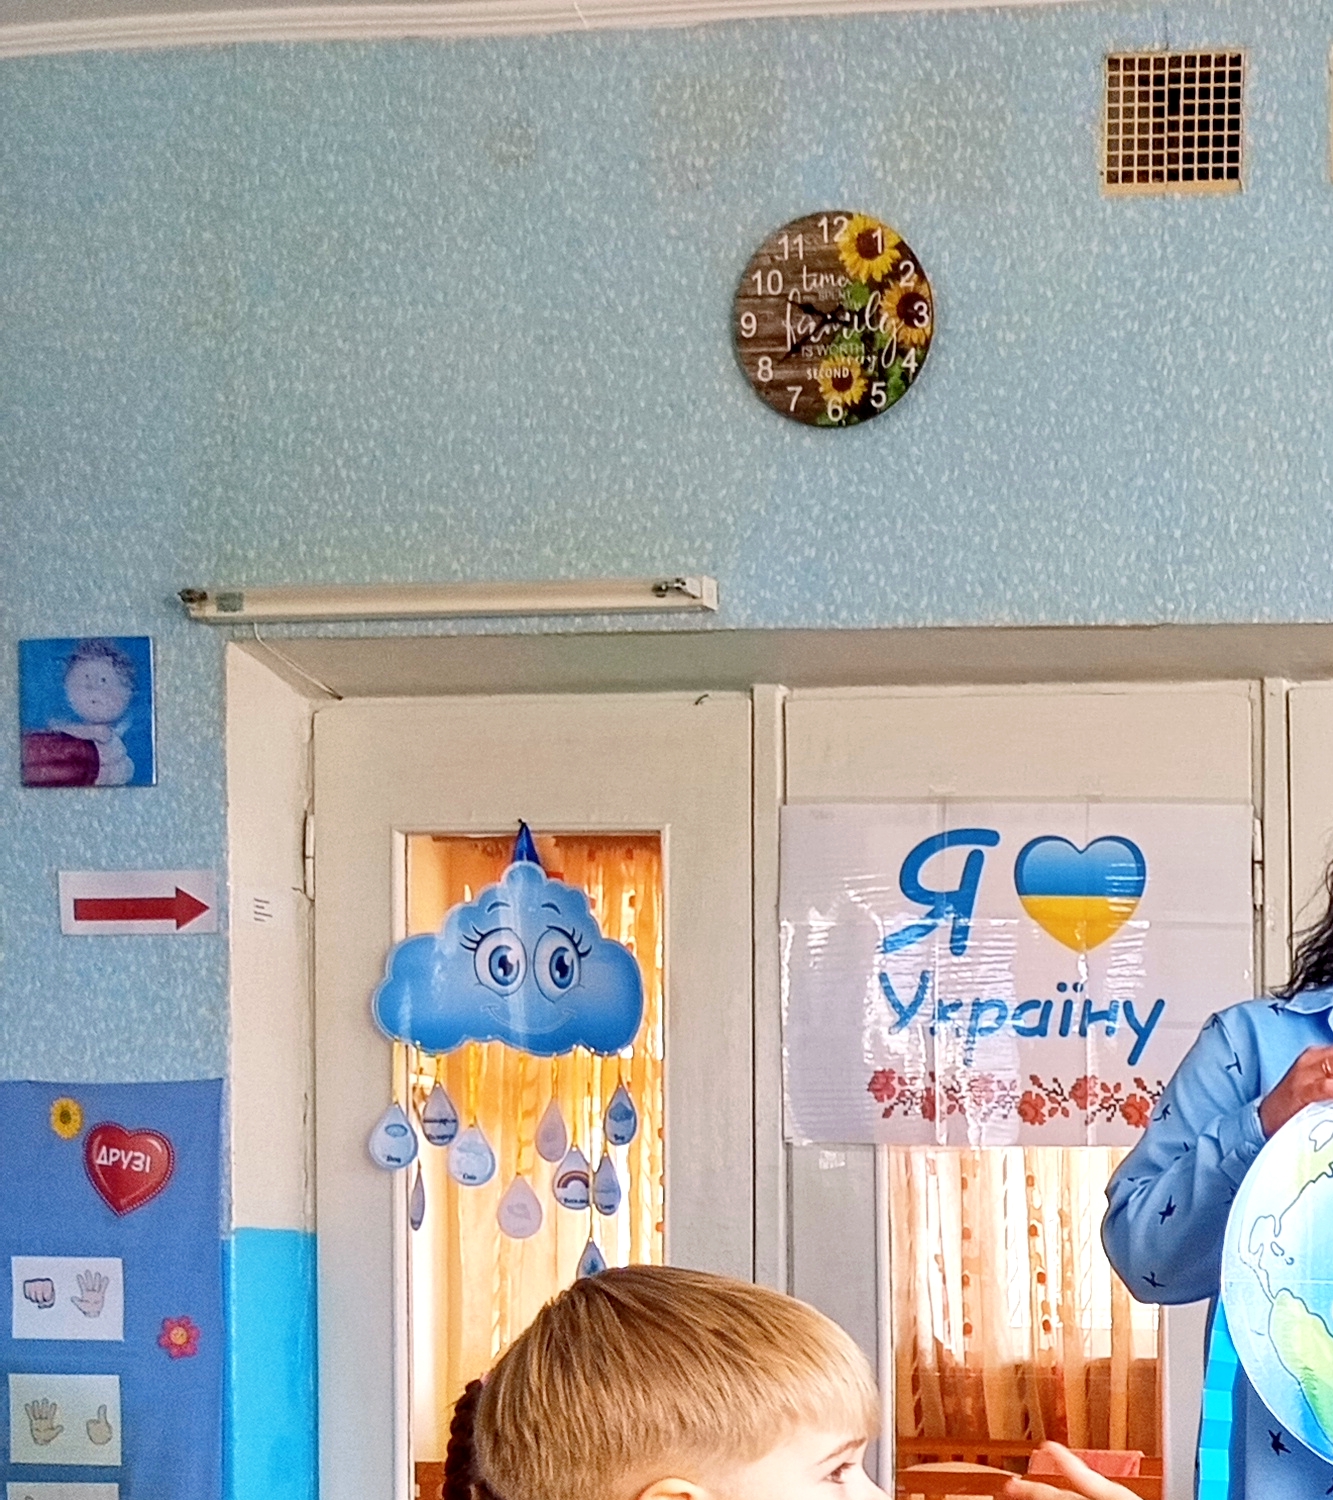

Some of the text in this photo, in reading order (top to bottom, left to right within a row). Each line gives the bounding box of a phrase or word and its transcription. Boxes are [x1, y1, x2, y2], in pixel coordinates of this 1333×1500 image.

[818, 216, 848, 243] 12
[872, 226, 884, 254] 1
[778, 233, 804, 260] 11
[752, 269, 783, 296] 10
[802, 264, 852, 291] time
[899, 260, 915, 287] 2
[740, 312, 757, 338] 9
[914, 302, 930, 328] 3
[757, 357, 773, 382] 8
[806, 367, 850, 380] SECOND
[901, 347, 918, 374] 4
[787, 386, 803, 412] 7
[870, 382, 887, 408] 5
[827, 397, 844, 422] 6
[879, 827, 1000, 957] Я
[879, 970, 1165, 1066] Україну
[96, 1145, 151, 1173] ДРУЗІ
